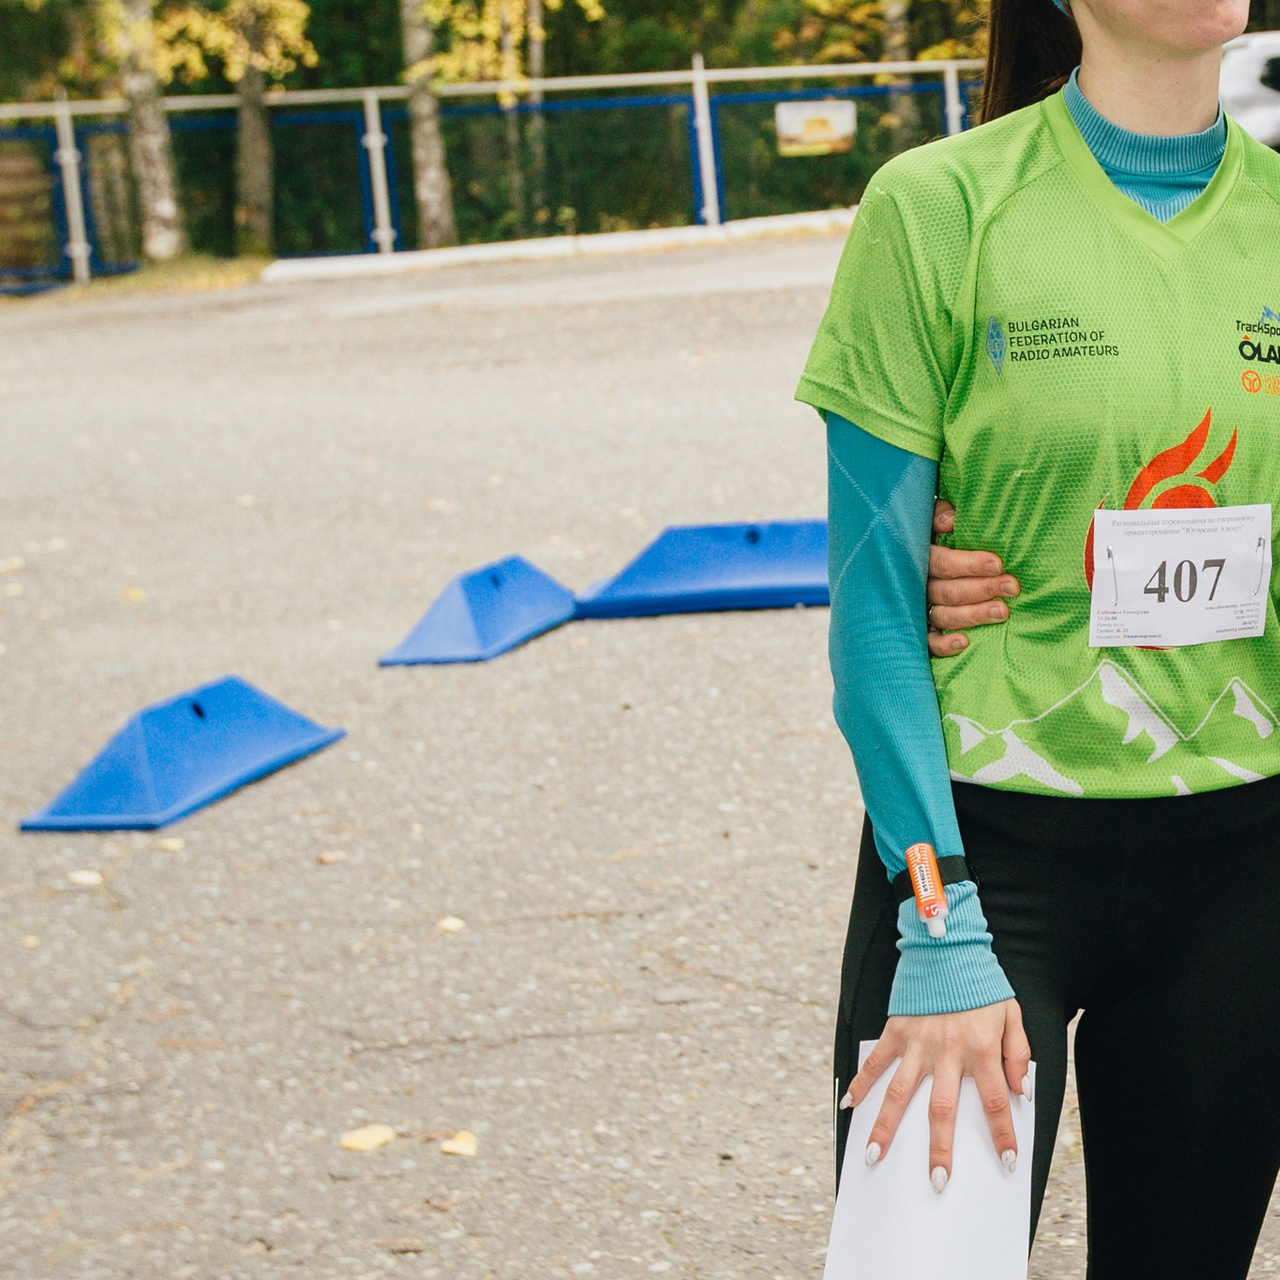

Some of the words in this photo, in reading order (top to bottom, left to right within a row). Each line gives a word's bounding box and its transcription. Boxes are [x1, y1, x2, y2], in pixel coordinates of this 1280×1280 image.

[1008, 317, 1080, 333] BULGARIAN
[1009, 332, 1088, 348] FEDERATION
[1089, 330, 1106, 342] OF
[1010, 347, 1051, 363] RADIO
[1052, 345, 1120, 360] AMATEURS
[1143, 558, 1226, 603] 407
